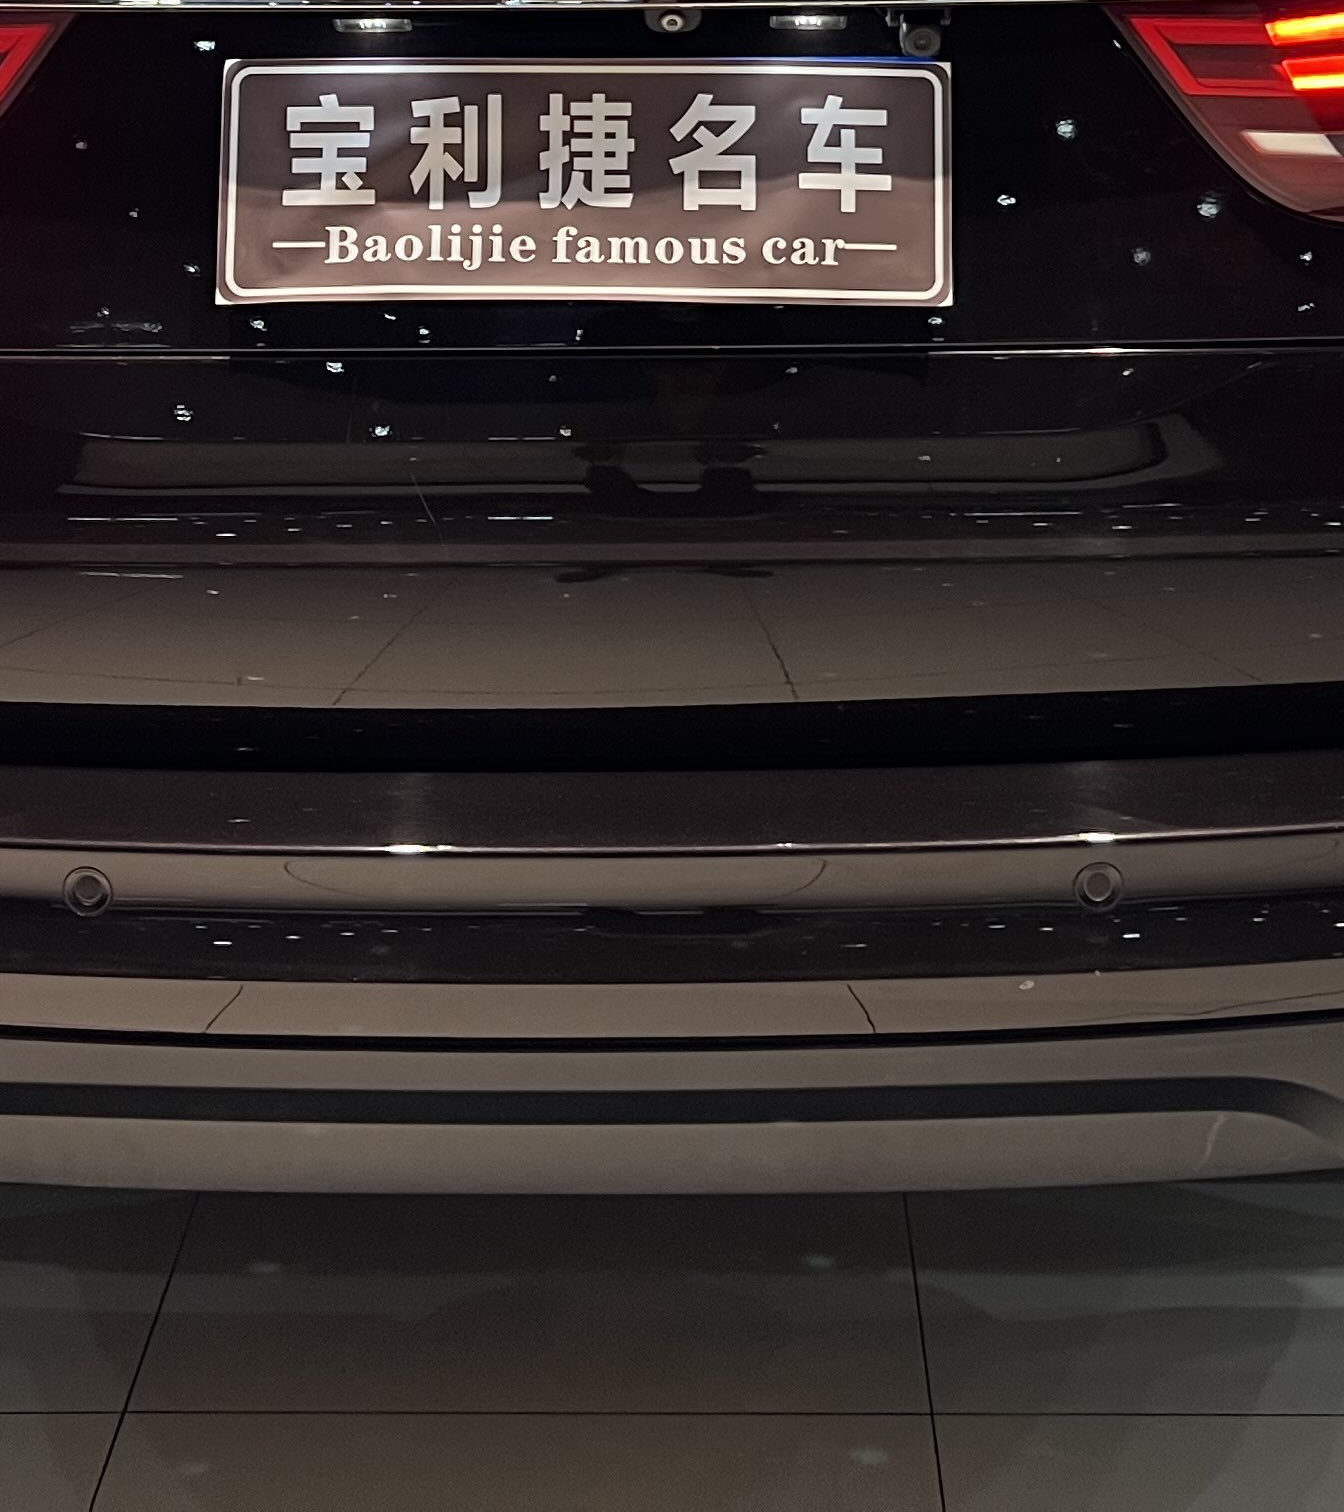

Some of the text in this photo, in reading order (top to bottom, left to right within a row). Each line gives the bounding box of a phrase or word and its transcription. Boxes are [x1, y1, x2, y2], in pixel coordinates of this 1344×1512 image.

[281, 92, 893, 214] 宝利捷名车
[552, 225, 747, 265] famous
